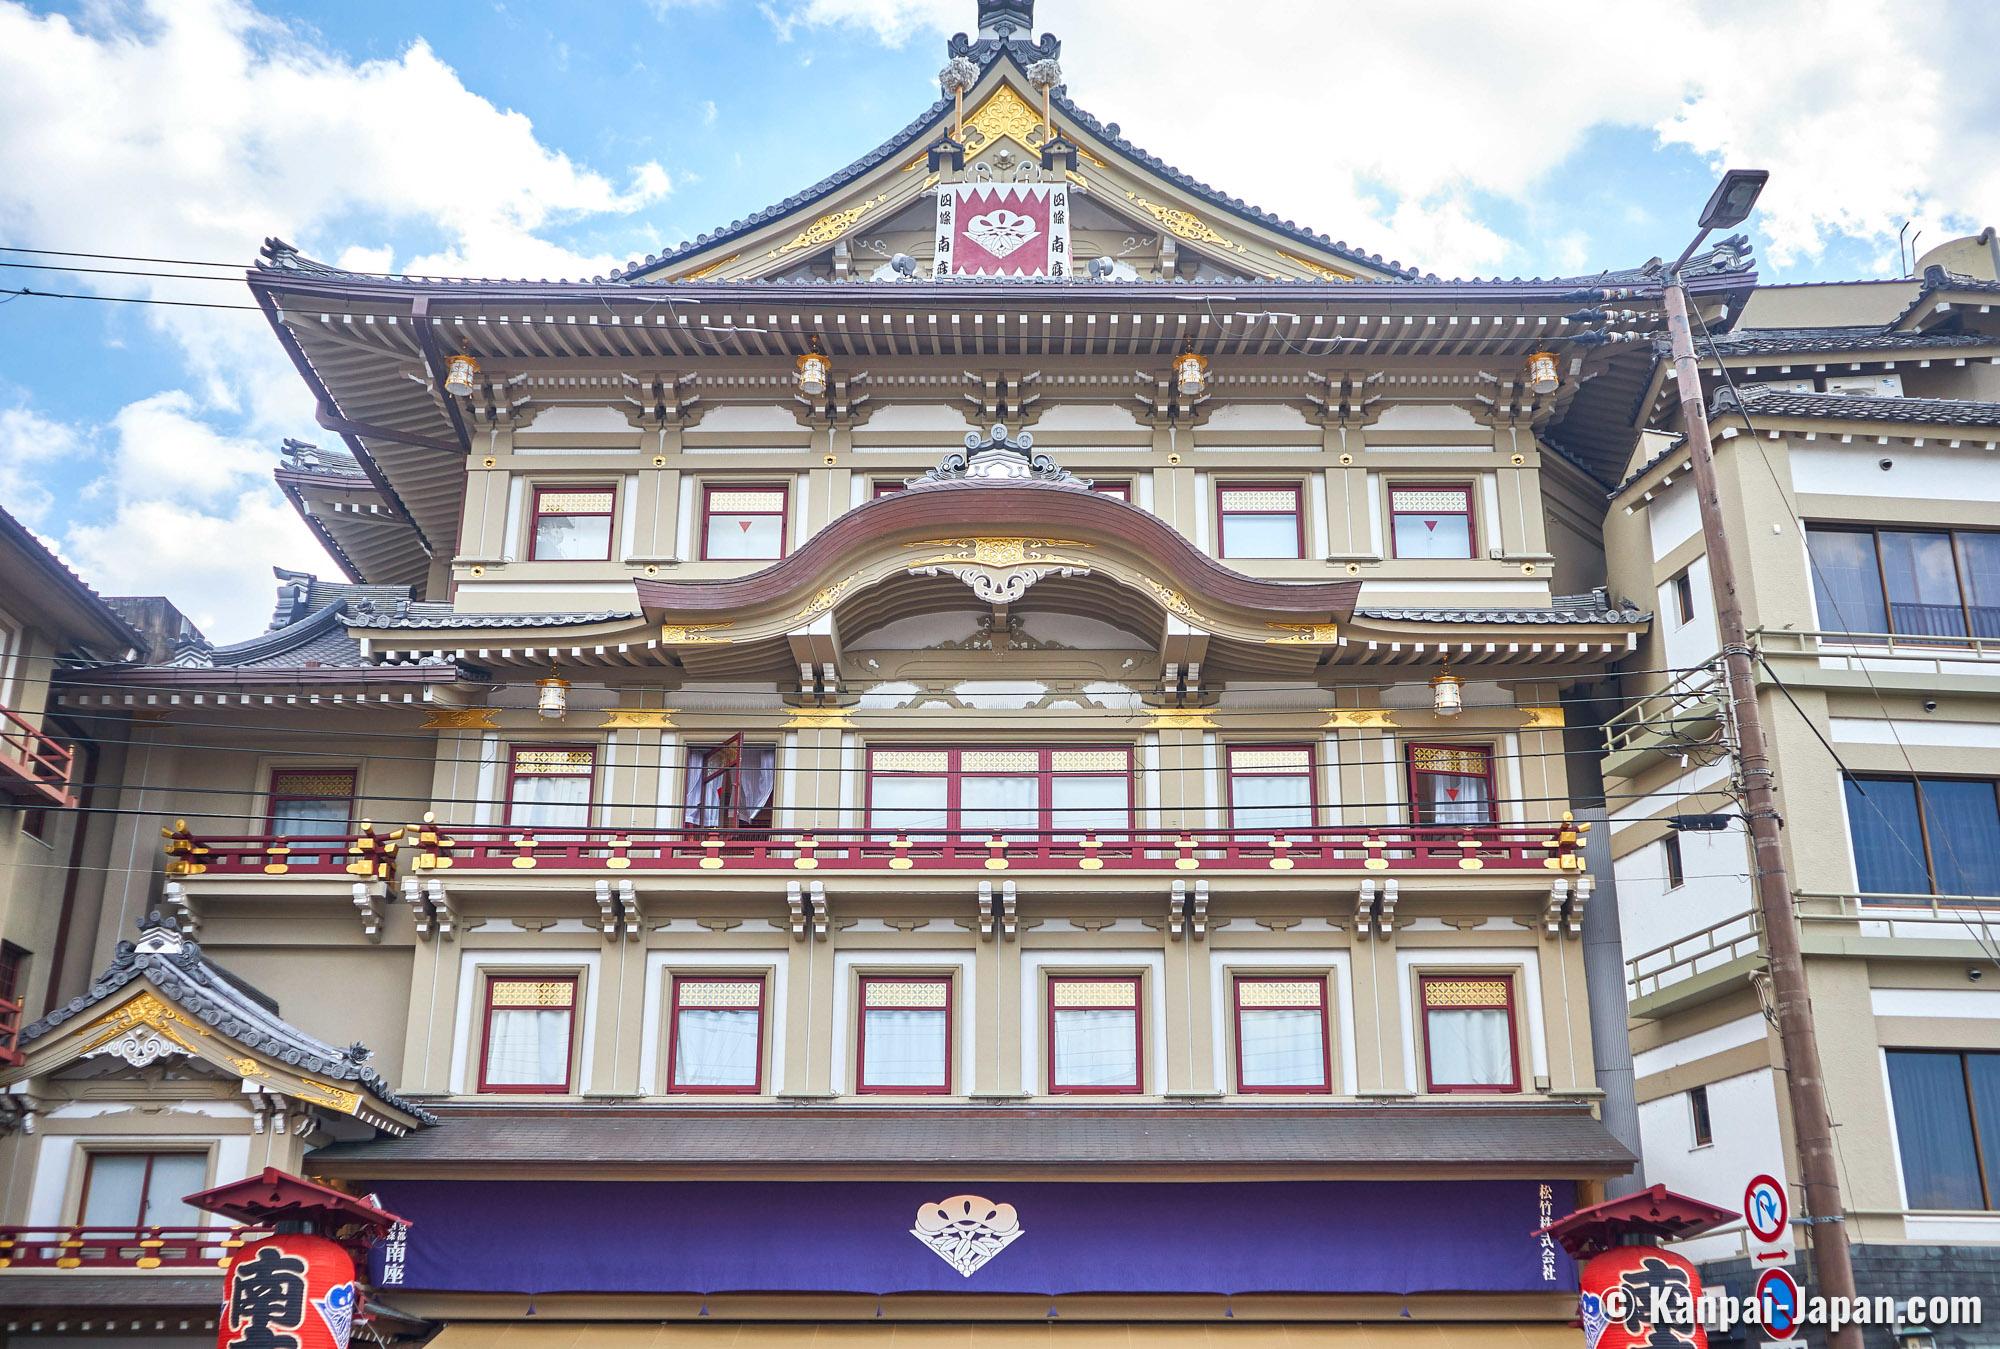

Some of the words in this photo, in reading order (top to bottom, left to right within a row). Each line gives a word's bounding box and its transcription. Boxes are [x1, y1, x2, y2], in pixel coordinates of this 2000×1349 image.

[1540, 1184, 1556, 1280] 松竹株式会社
[227, 1246, 308, 1349] 南
